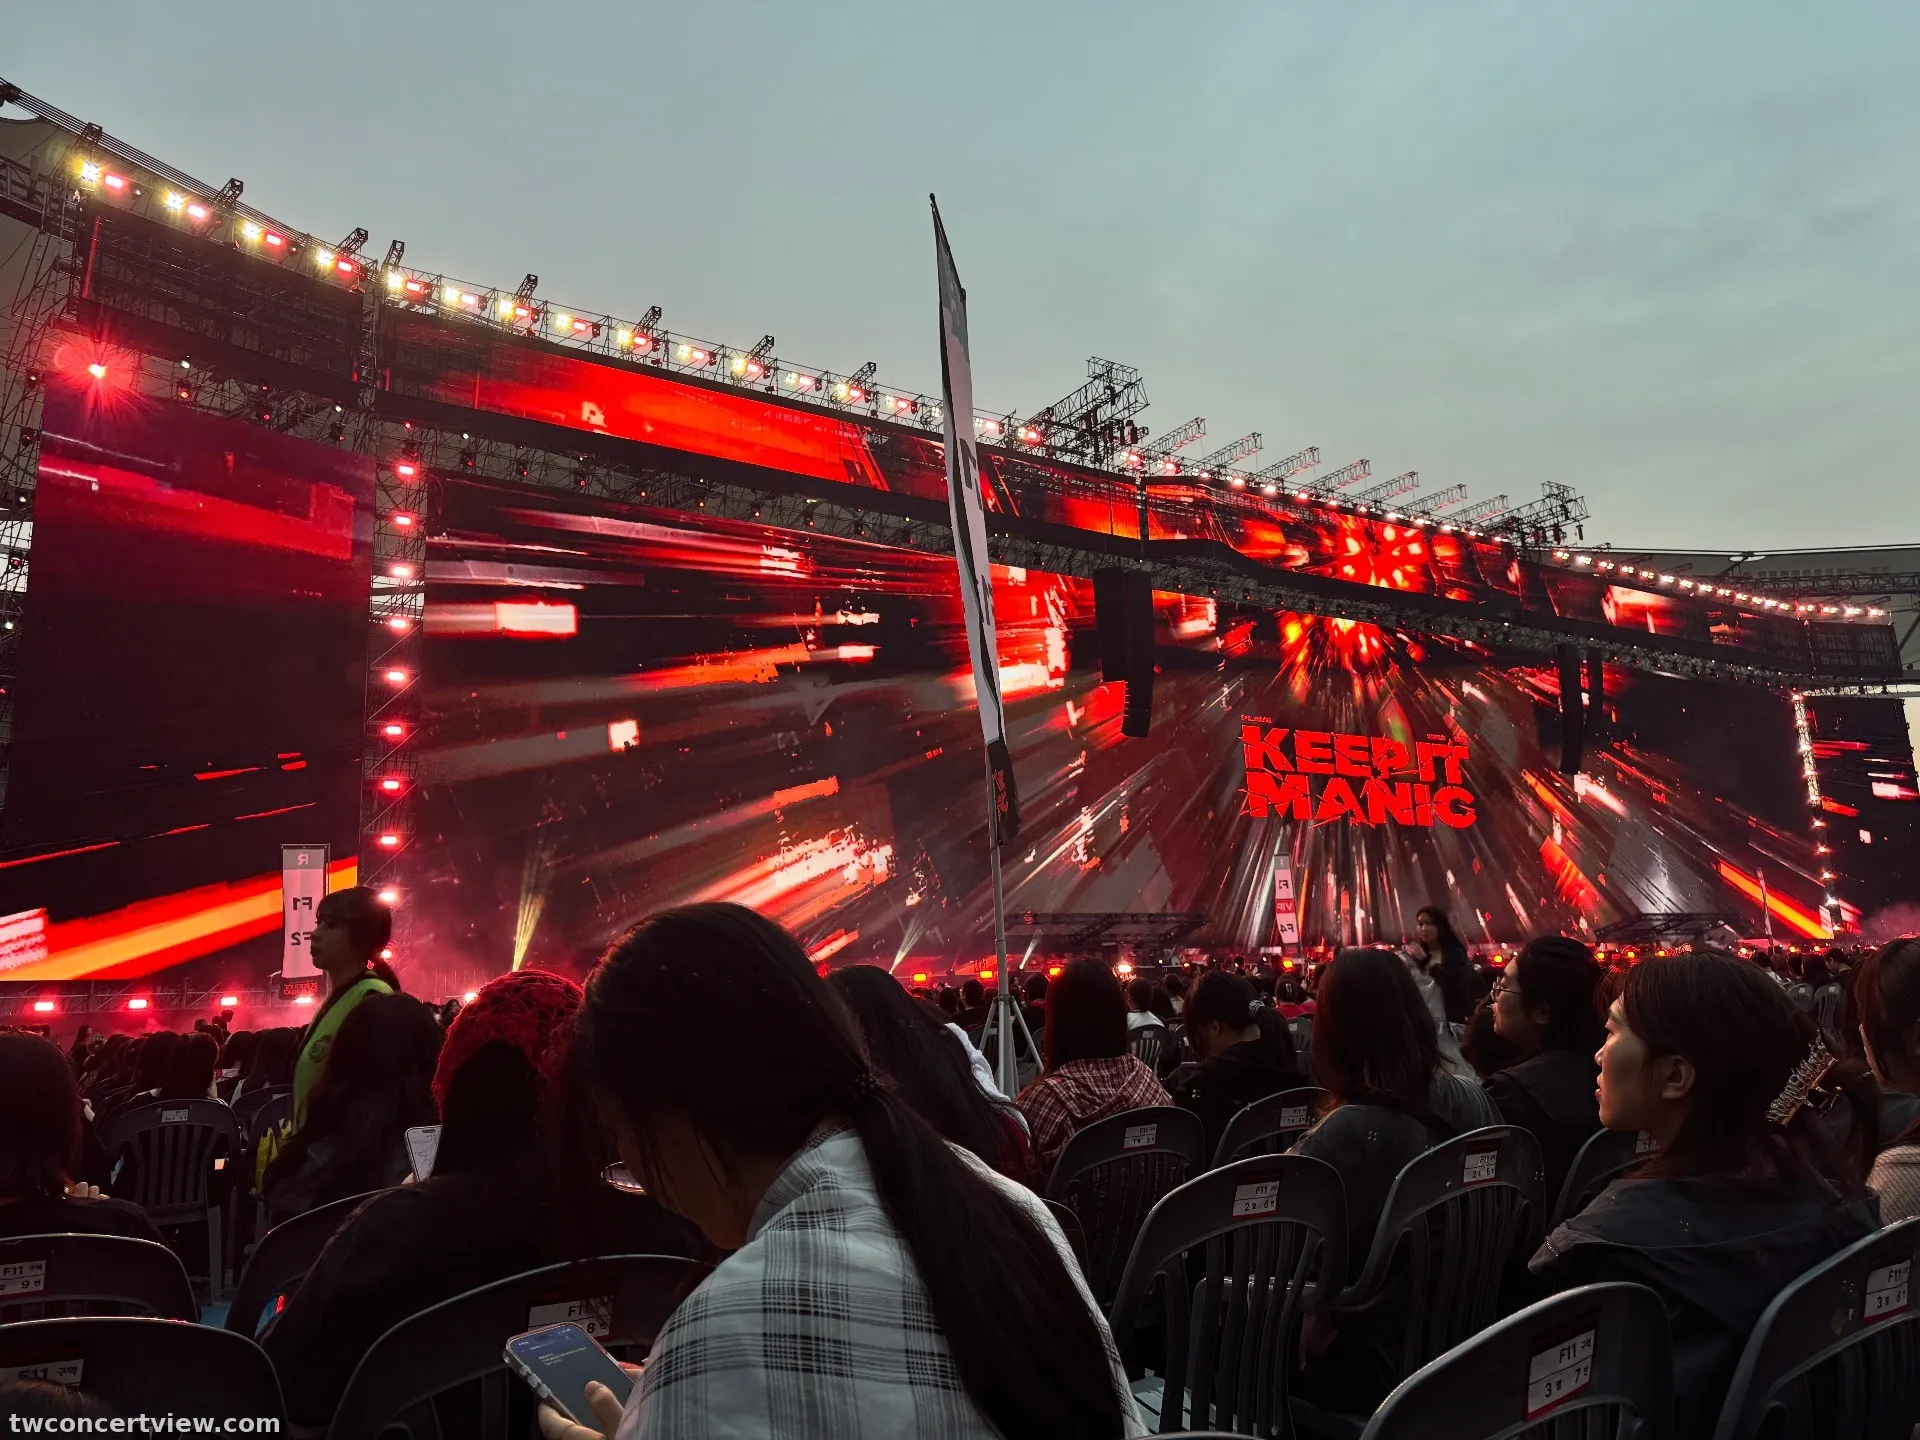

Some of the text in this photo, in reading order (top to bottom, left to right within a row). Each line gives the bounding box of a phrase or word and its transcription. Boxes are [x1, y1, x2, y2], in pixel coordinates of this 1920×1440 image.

[1239, 725, 1470, 785] KEEP IT
[1238, 771, 1478, 830] MANIC
[1255, 1185, 1268, 1195] F11
[1244, 1202, 1250, 1211] 2
[1263, 1199, 1269, 1208] 6
[3, 1265, 24, 1276] F11
[21, 1280, 30, 1289] 9
[1877, 1296, 1883, 1309] 3
[586, 1322, 596, 1334] 8
[1559, 1342, 1577, 1364] F11
[1545, 1382, 1552, 1398] 3
[1575, 1368, 1581, 1383] 7
